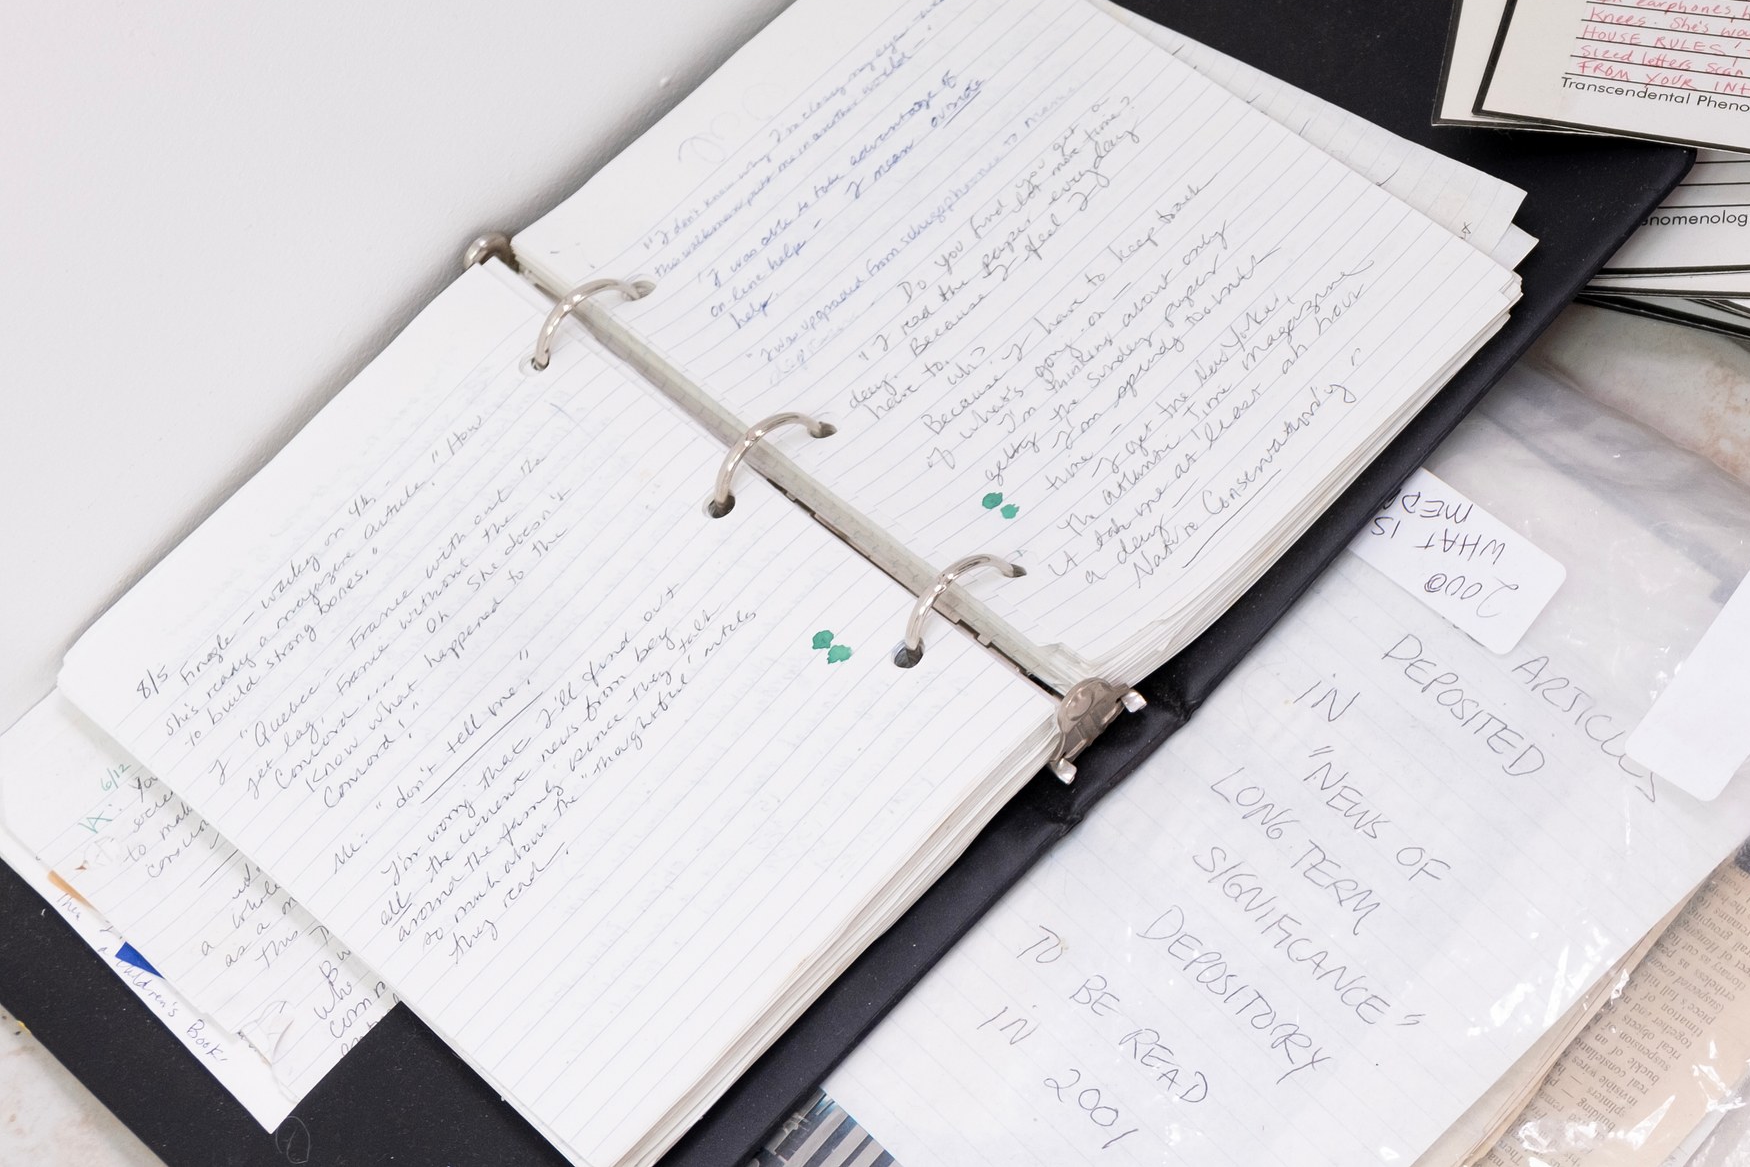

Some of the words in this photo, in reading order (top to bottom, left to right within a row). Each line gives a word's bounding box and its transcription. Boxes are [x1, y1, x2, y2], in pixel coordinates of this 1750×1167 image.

[1562, 76, 1690, 105] Transcendental
[1371, 517, 1401, 539] IS
[1413, 528, 1506, 565] WHAT
[423, 598, 502, 667] happened
[1293, 676, 1361, 722] IN
[1381, 633, 1546, 776] DEPOSITED
[1210, 766, 1300, 840] LONG
[1291, 838, 1383, 936] TERM
[1395, 845, 1451, 882] OF
[1016, 924, 1064, 965] TO
[1069, 974, 1122, 1018] BE
[1118, 1027, 1209, 1105] READ
[1136, 904, 1334, 1086] DEPOSITORY
[976, 1005, 1039, 1045] IN
[1043, 1067, 1139, 1151] 2001
[1627, 1056, 1660, 1086] buckle
